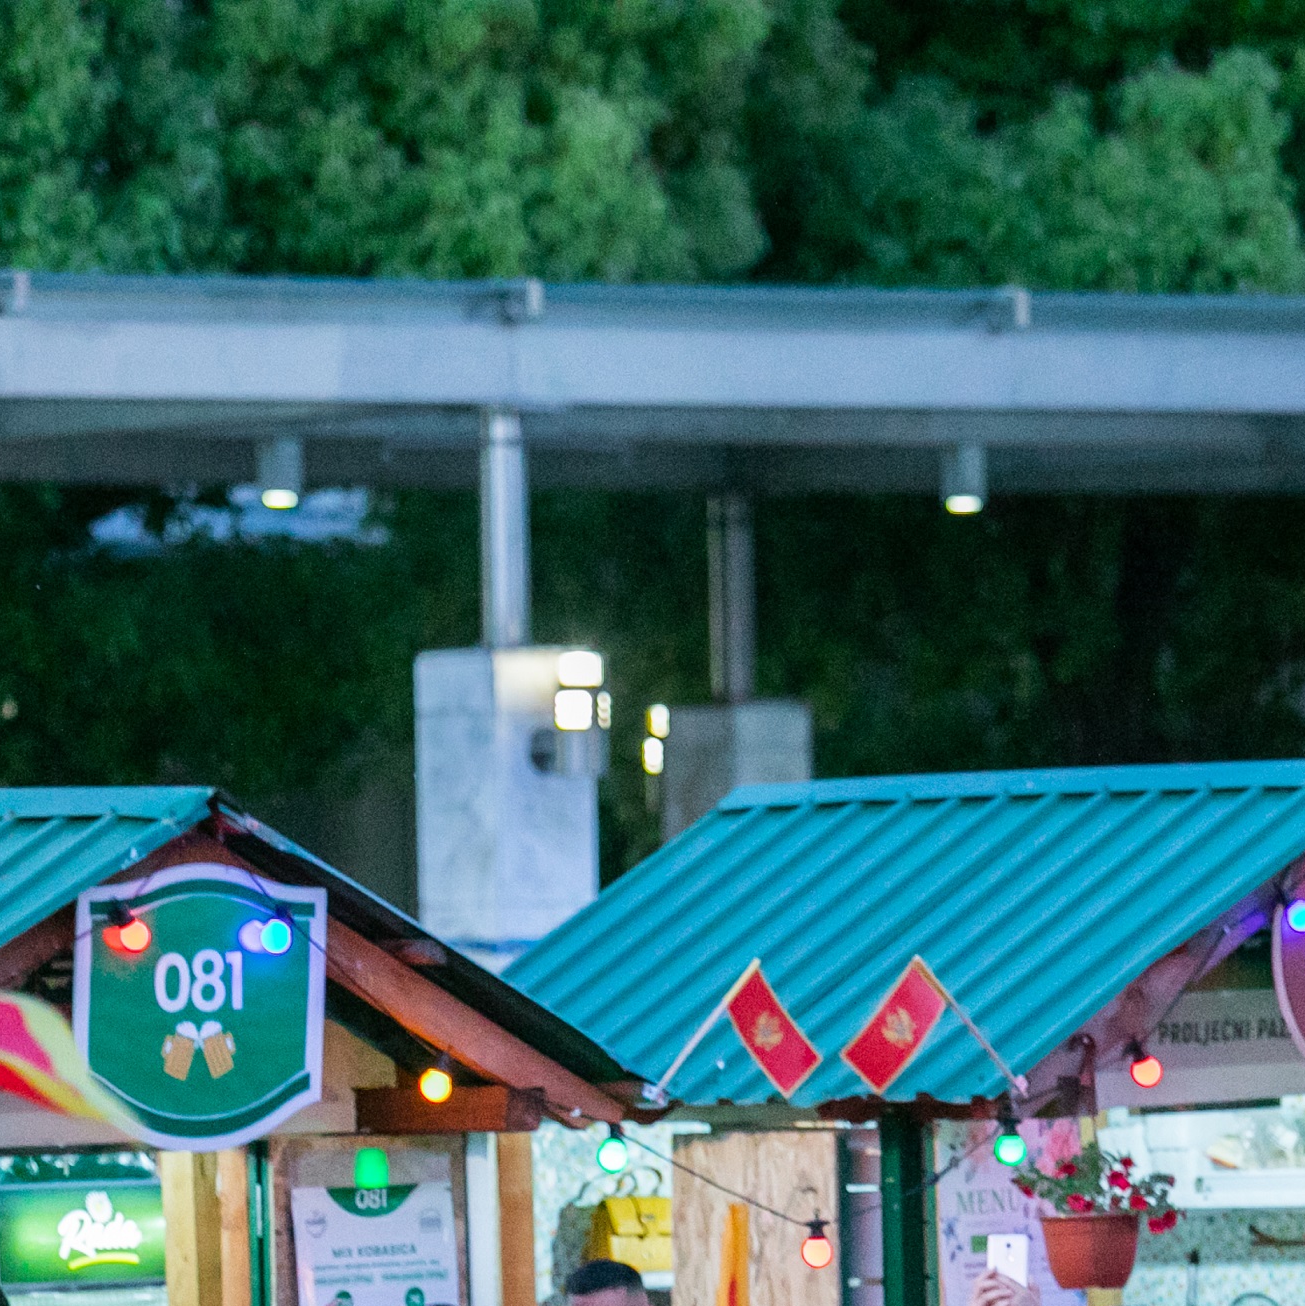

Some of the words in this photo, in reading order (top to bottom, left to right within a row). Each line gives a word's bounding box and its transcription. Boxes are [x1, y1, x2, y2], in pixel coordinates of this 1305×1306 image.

[154, 948, 244, 1014] 081
[1257, 1017, 1292, 1040] PAZ
[354, 1188, 388, 1210] 081
